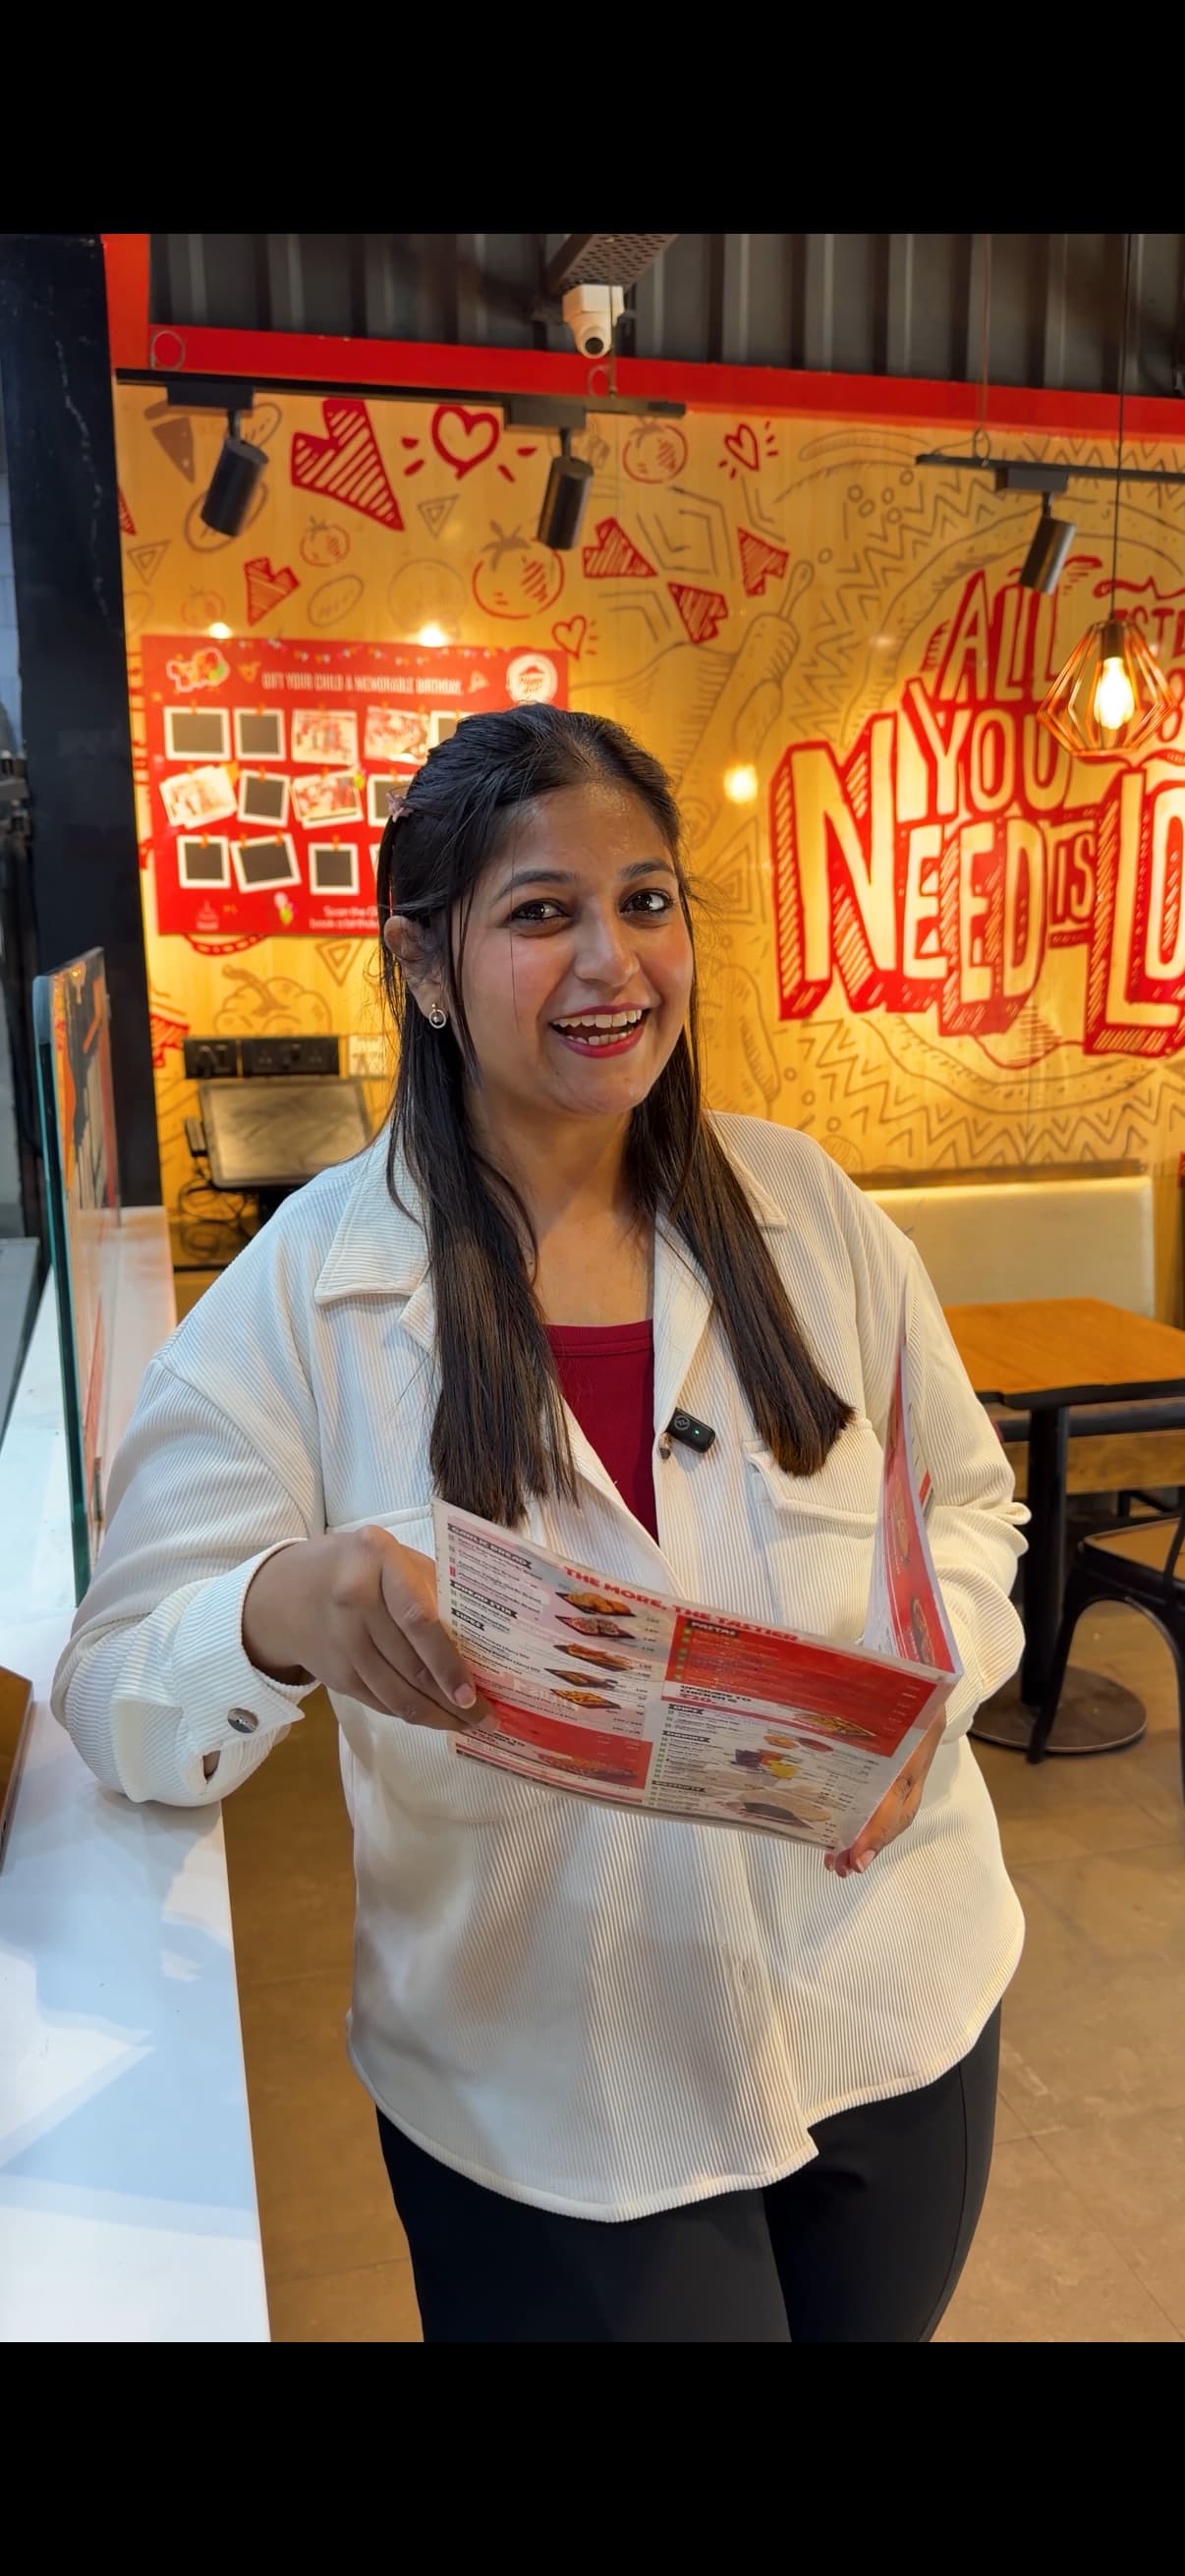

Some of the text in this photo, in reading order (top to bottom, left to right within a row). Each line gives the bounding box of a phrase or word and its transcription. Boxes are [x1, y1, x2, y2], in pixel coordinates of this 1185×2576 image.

[933, 570, 1073, 701] ALL
[902, 678, 1073, 823] YOU
[771, 711, 1048, 1032] NEED
[1051, 830, 1096, 922] IS
[563, 1565, 601, 1589] THE
[604, 1581, 668, 1611] MORE,
[672, 1603, 712, 1623] THE
[690, 1621, 736, 1637] PASTAS
